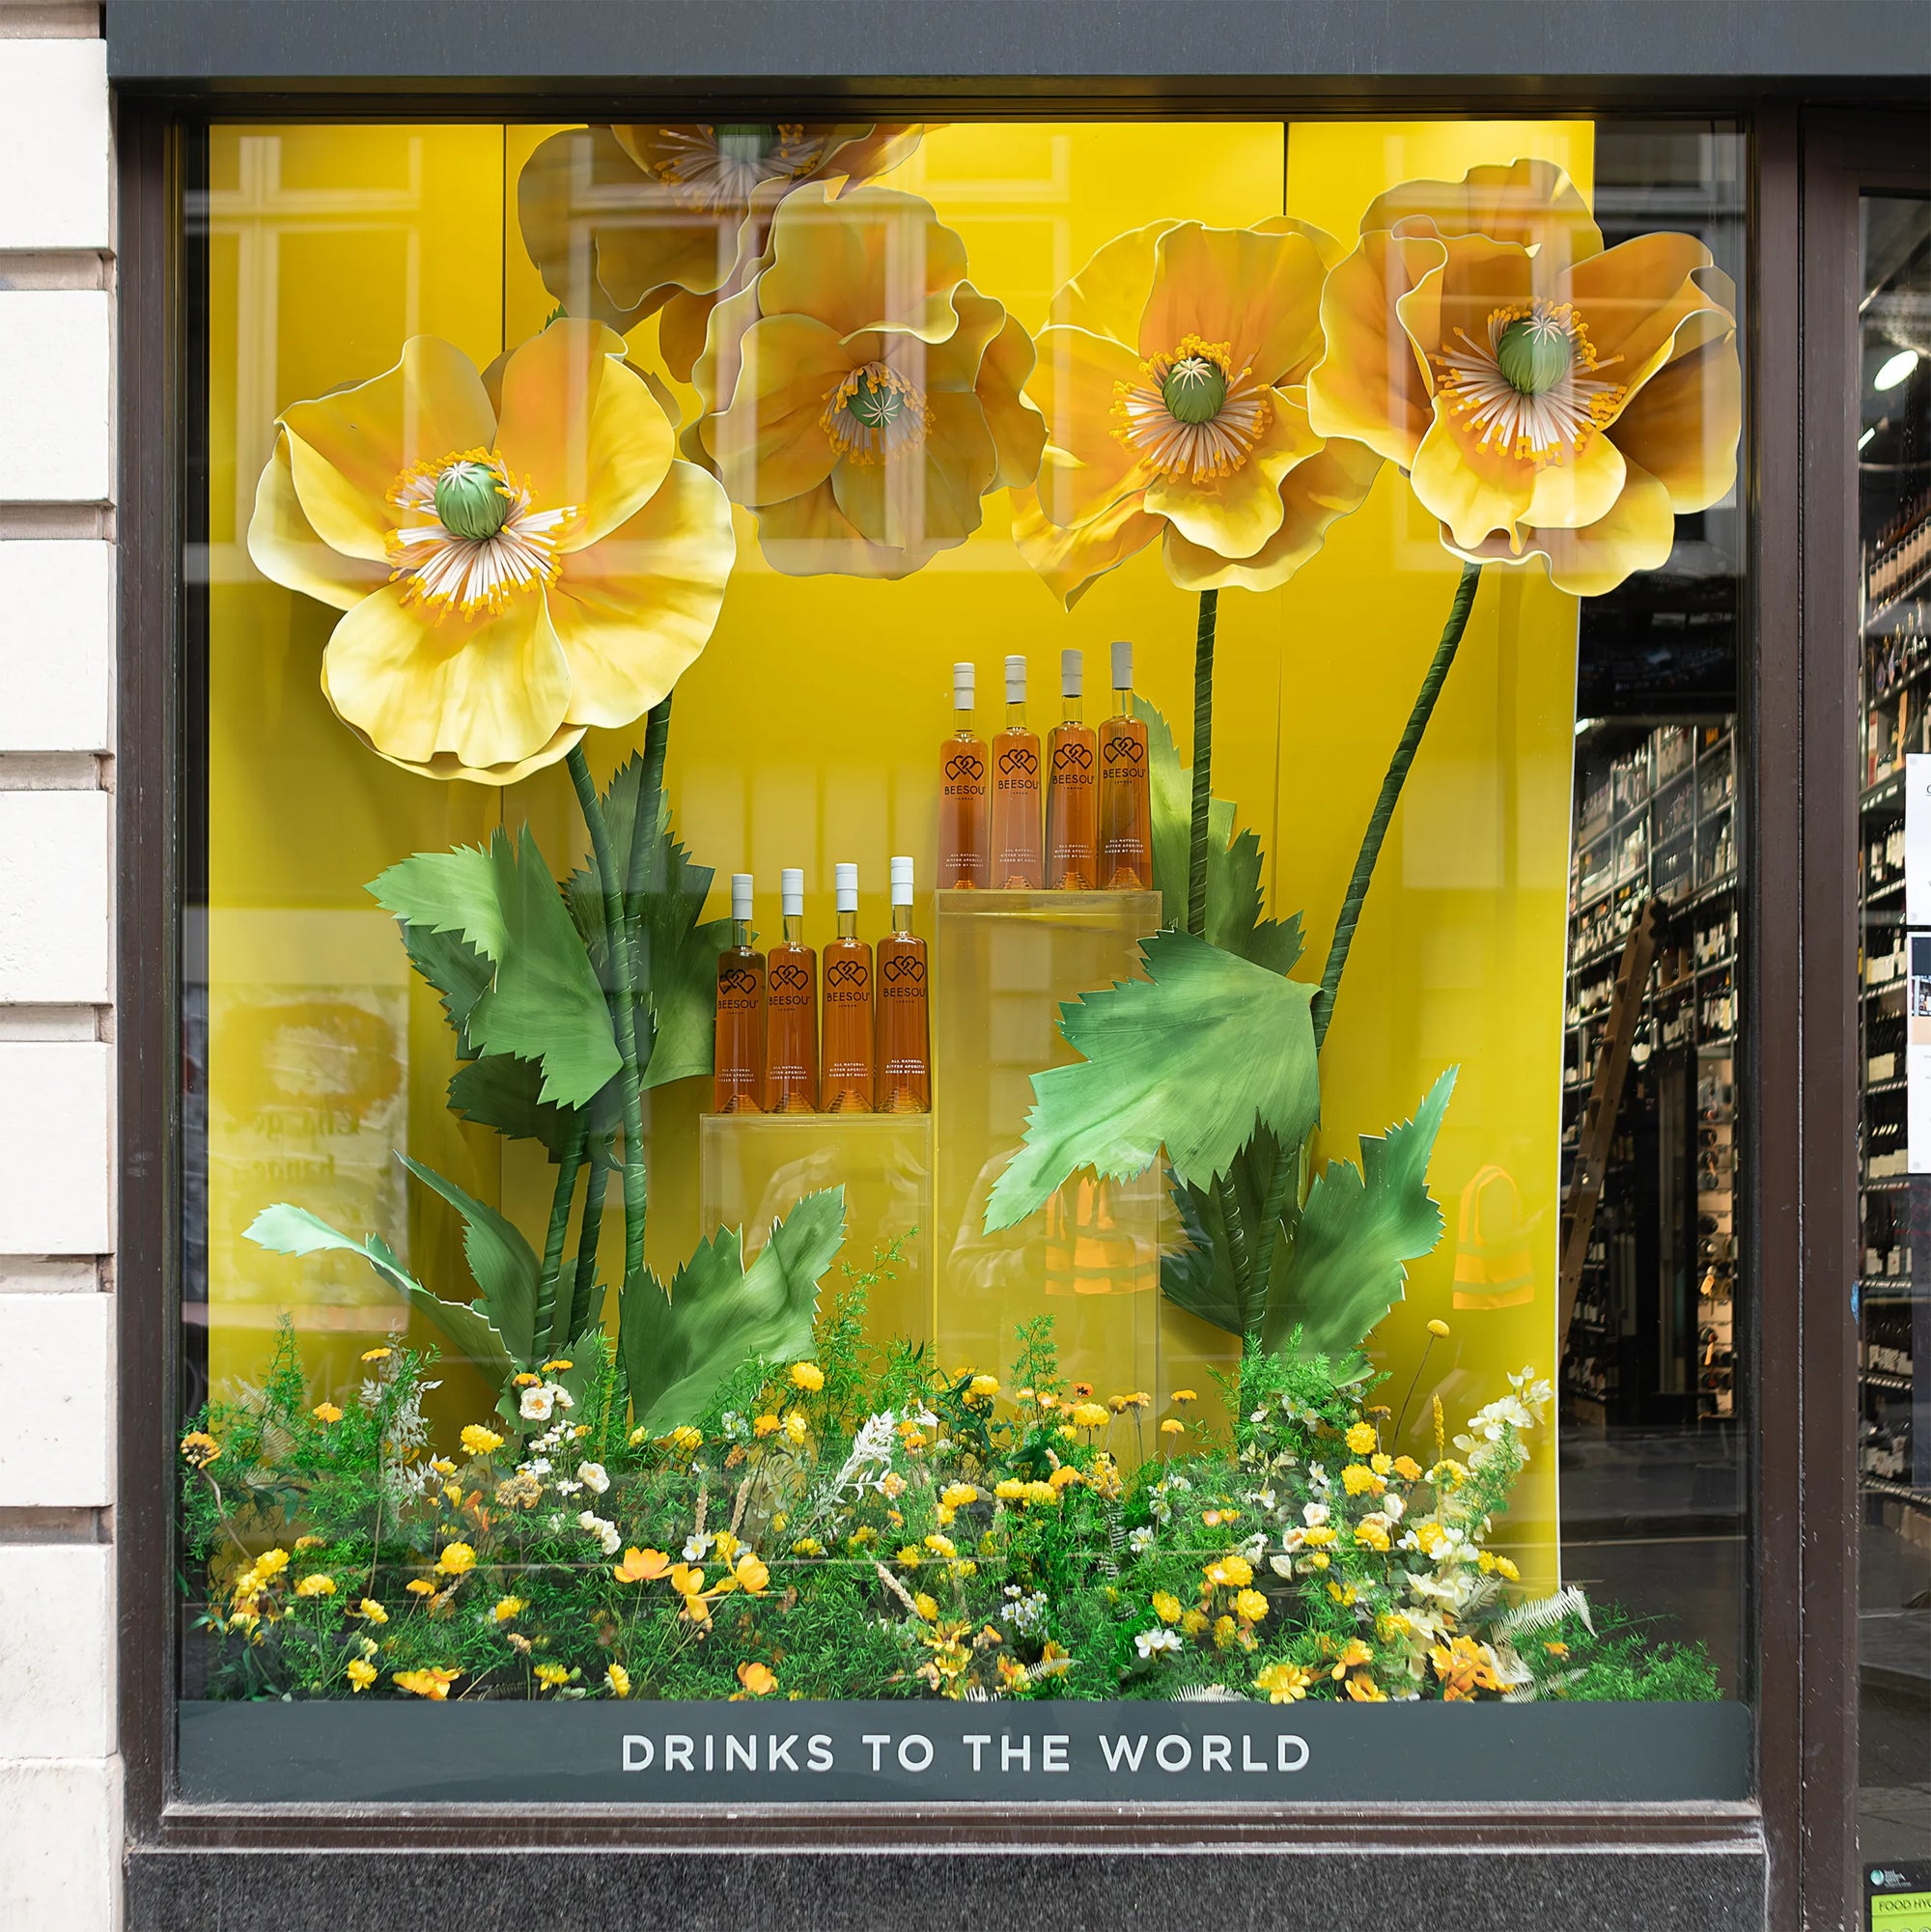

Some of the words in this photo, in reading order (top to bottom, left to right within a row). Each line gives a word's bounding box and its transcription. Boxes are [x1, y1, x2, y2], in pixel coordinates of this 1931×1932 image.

[1052, 774, 1093, 784] BEESOU
[1104, 768, 1143, 779] BEESOU
[998, 779, 1038, 790] BEESOU
[945, 785, 984, 796] BEESOU
[770, 995, 809, 1006] BEESOU
[826, 992, 868, 1002] BEESOU
[718, 999, 757, 1009] BEESOU
[622, 1734, 834, 1772] DRINKS
[862, 1734, 935, 1773] TO
[963, 1734, 1070, 1772] THE
[1098, 1734, 1310, 1773] WORLD
[1878, 1899, 1912, 1912] FOOD
